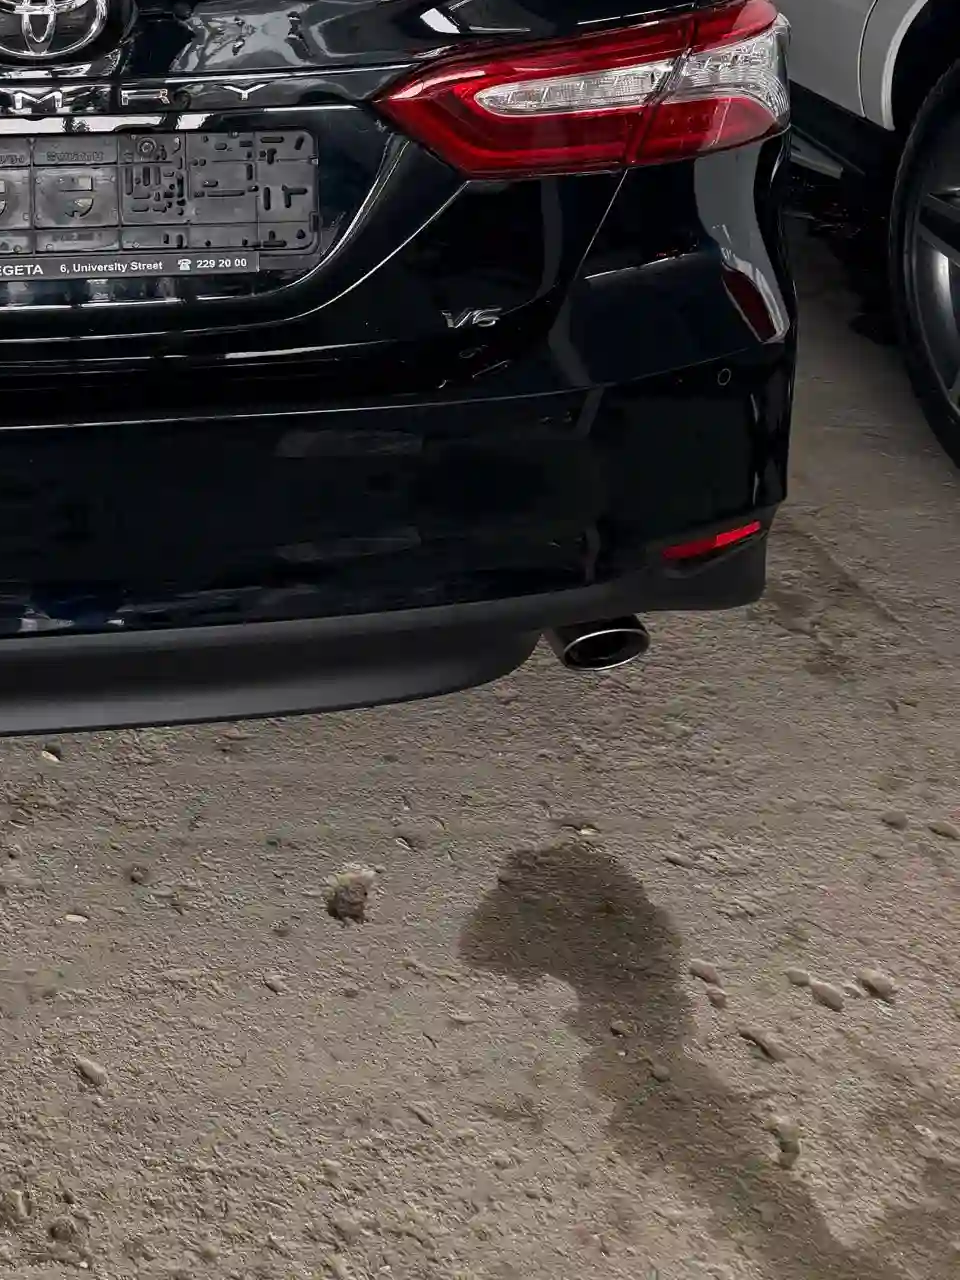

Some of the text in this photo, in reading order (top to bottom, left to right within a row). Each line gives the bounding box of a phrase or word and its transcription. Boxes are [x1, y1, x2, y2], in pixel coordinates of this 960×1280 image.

[59, 263, 71, 275] 6,
[72, 261, 129, 275] University
[130, 260, 163, 271] Street
[196, 259, 216, 269] 229
[218, 259, 232, 268] 20
[233, 257, 248, 268] 00
[440, 306, 502, 328] V6
